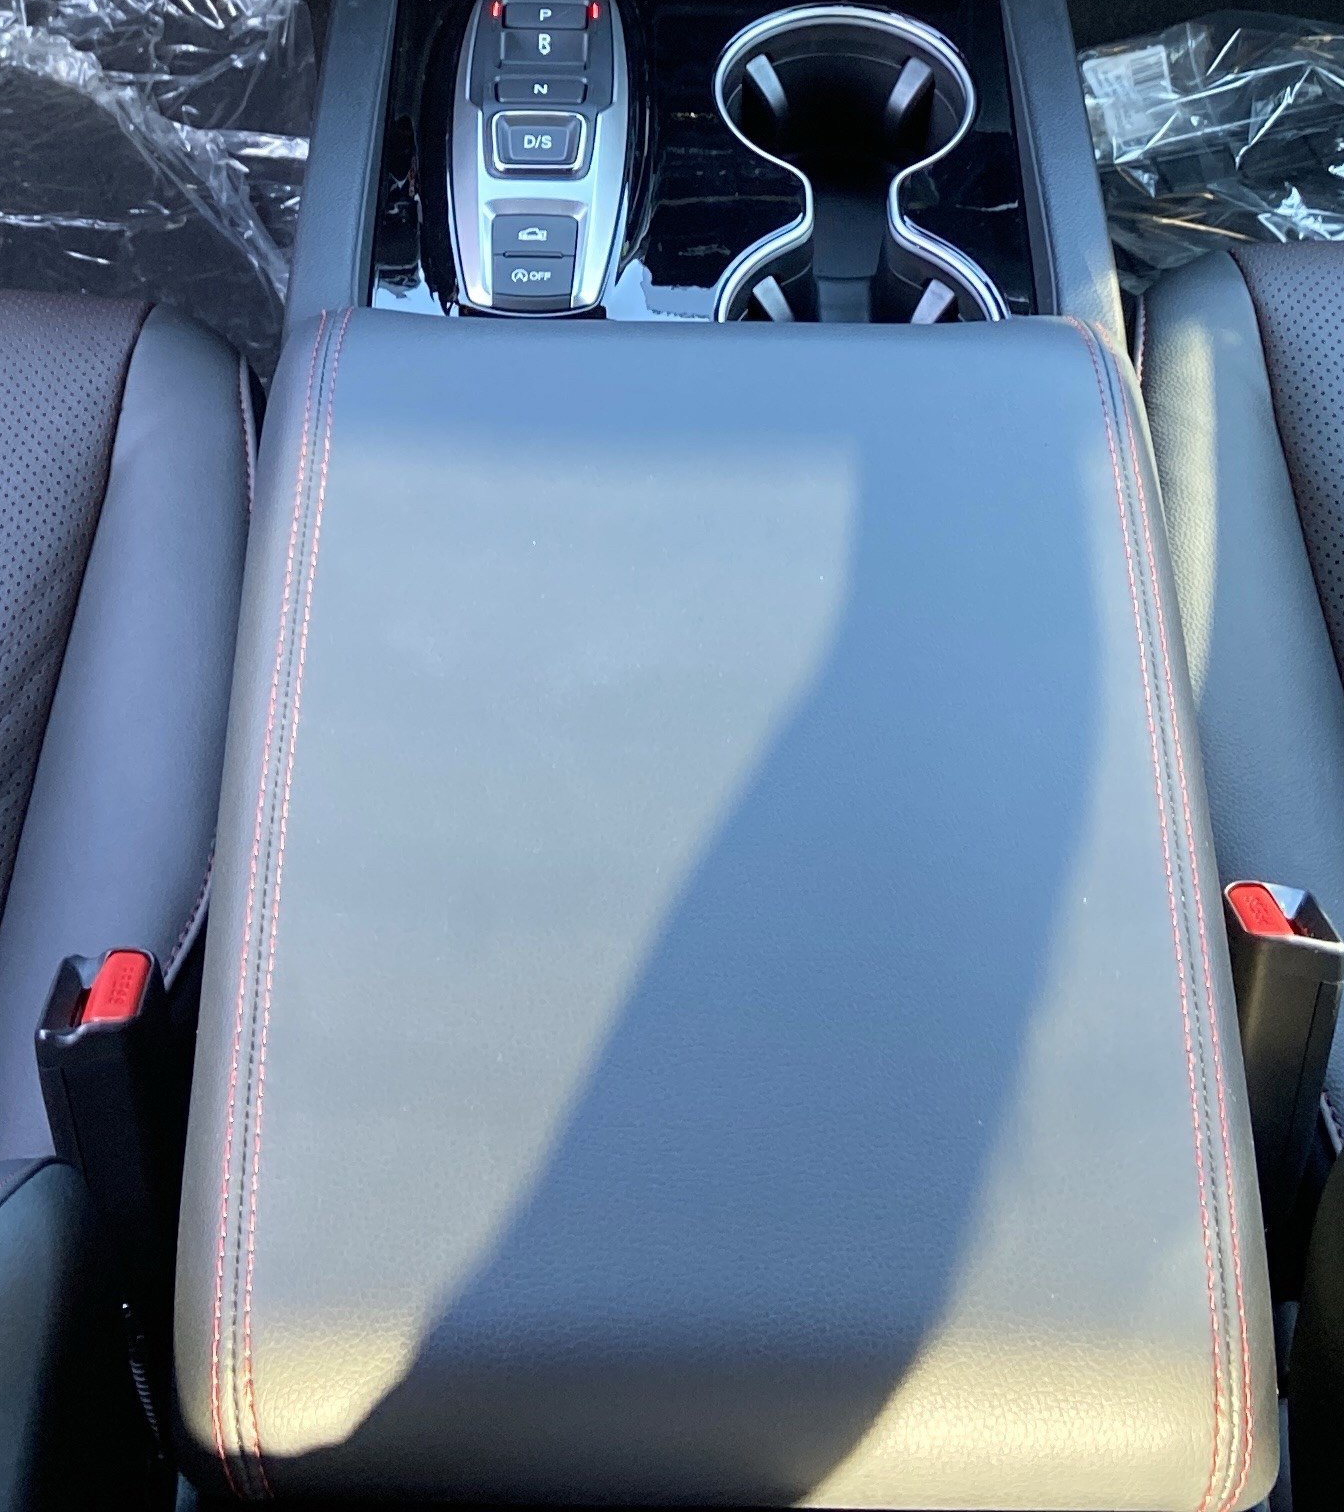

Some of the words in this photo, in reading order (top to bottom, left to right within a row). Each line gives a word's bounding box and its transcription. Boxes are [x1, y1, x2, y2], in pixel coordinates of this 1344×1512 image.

[539, 8, 553, 21] P
[533, 84, 548, 94] N
[523, 135, 553, 149] D/S
[529, 271, 552, 282] OFF
